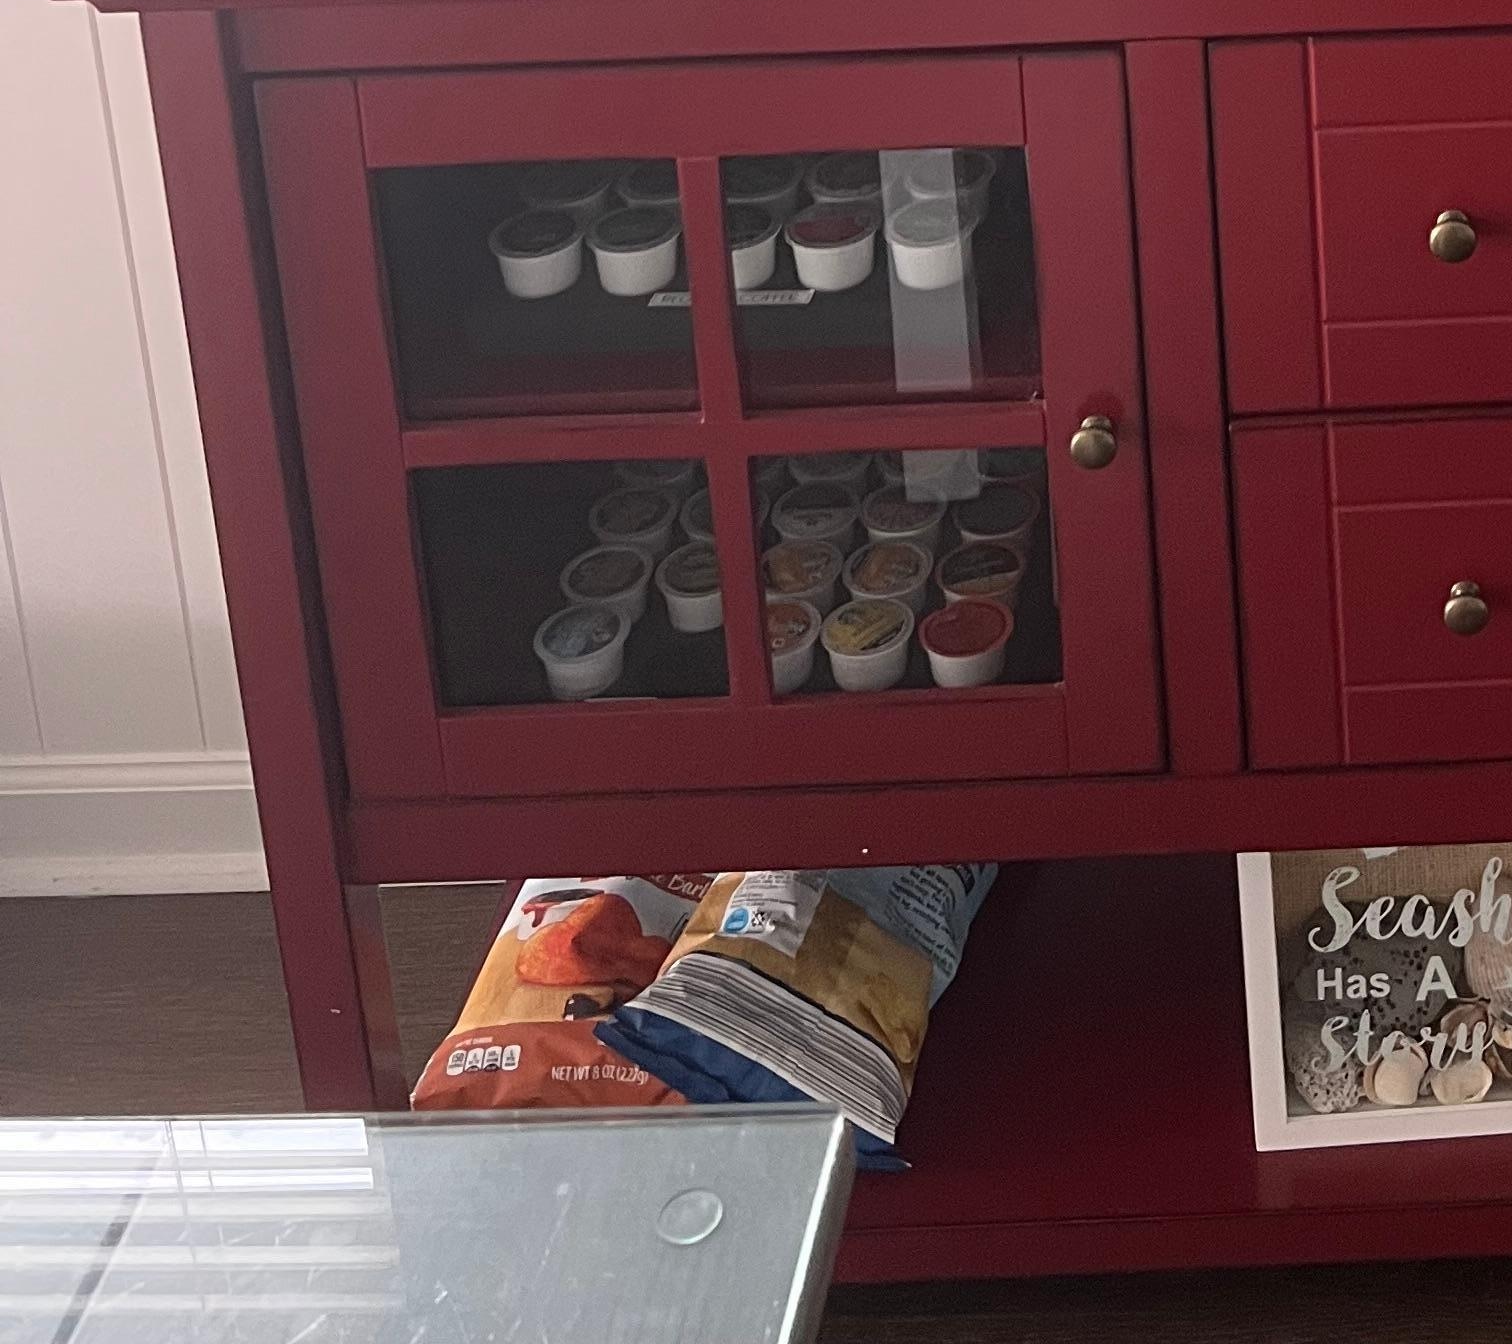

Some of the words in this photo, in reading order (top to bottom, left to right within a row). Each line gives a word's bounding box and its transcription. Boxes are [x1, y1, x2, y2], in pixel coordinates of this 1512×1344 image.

[1316, 966, 1391, 1002] Has
[1415, 955, 1458, 1002] A
[1311, 1008, 1494, 1074] Story
[551, 1066, 571, 1081] NET
[573, 1066, 590, 1081] WT
[592, 1064, 600, 1080] 8
[601, 1064, 616, 1079] OZ
